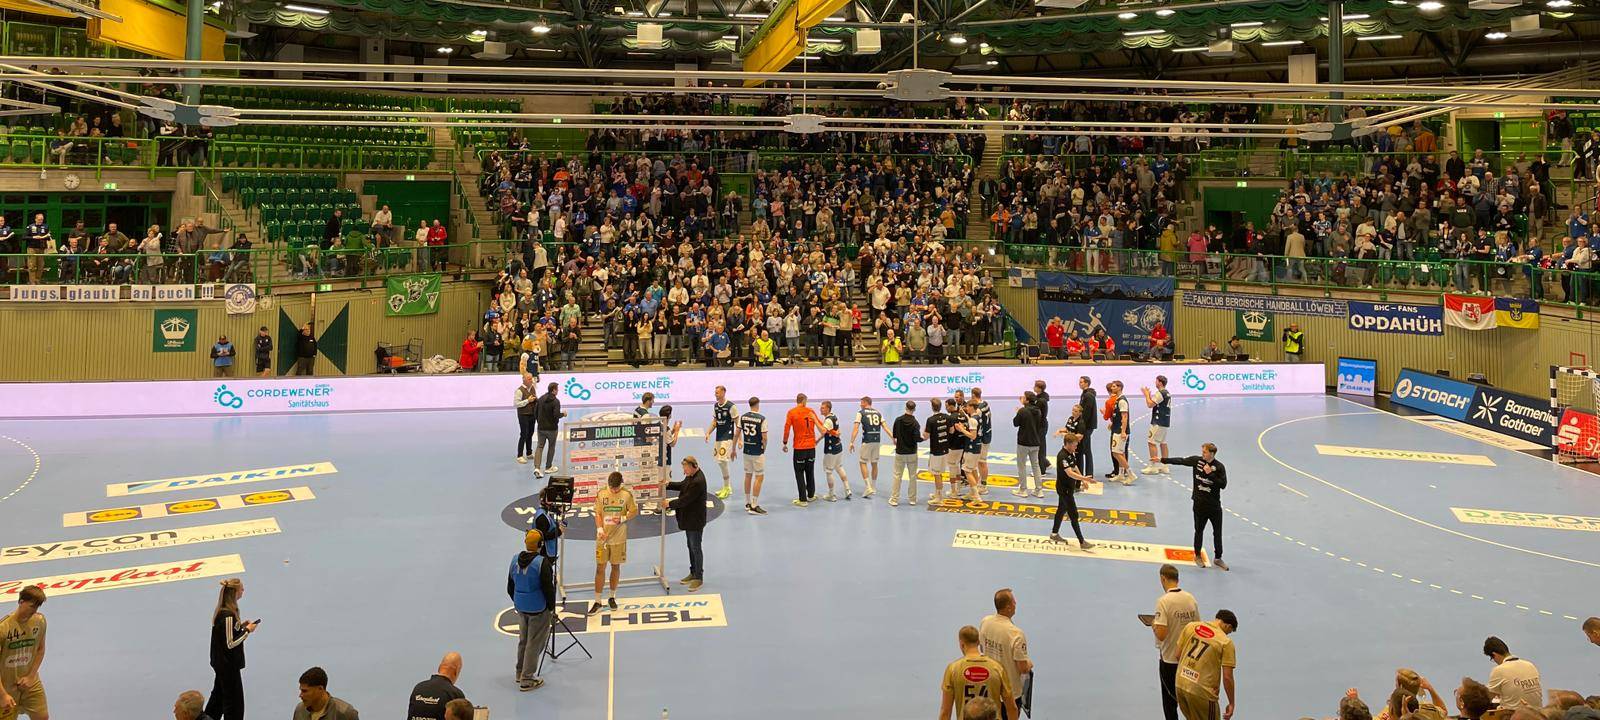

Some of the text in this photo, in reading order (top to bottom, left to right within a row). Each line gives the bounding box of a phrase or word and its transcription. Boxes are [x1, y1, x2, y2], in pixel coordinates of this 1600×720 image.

[14, 288, 59, 300] Jungs,
[69, 288, 116, 300] glaubt
[133, 289, 150, 299] an
[158, 288, 193, 299] euch
[202, 286, 213, 298] !!!
[1193, 295, 1224, 305] FANCLUB
[1225, 297, 1264, 309] BERGISCHE
[1266, 302, 1304, 312] HANDBALL
[1350, 314, 1442, 333] OPDAHÜH
[288, 399, 330, 408] Sanitätshaus
[867, 414, 880, 426] 18
[1499, 415, 1545, 437] Gothaer
[595, 428, 620, 438] DAIKIN
[622, 426, 637, 437] HBL
[743, 422, 757, 436] 53
[167, 466, 315, 488] DAIKIN
[935, 508, 1049, 519] PROTECTING
[1109, 510, 1146, 520] IT
[223, 526, 277, 539] BORD
[954, 540, 1072, 552] HAUSTECHNIK
[623, 601, 709, 610] DAIKIN
[601, 610, 712, 626] HBL
[7, 628, 20, 641] 44
[1187, 636, 1210, 661] 27
